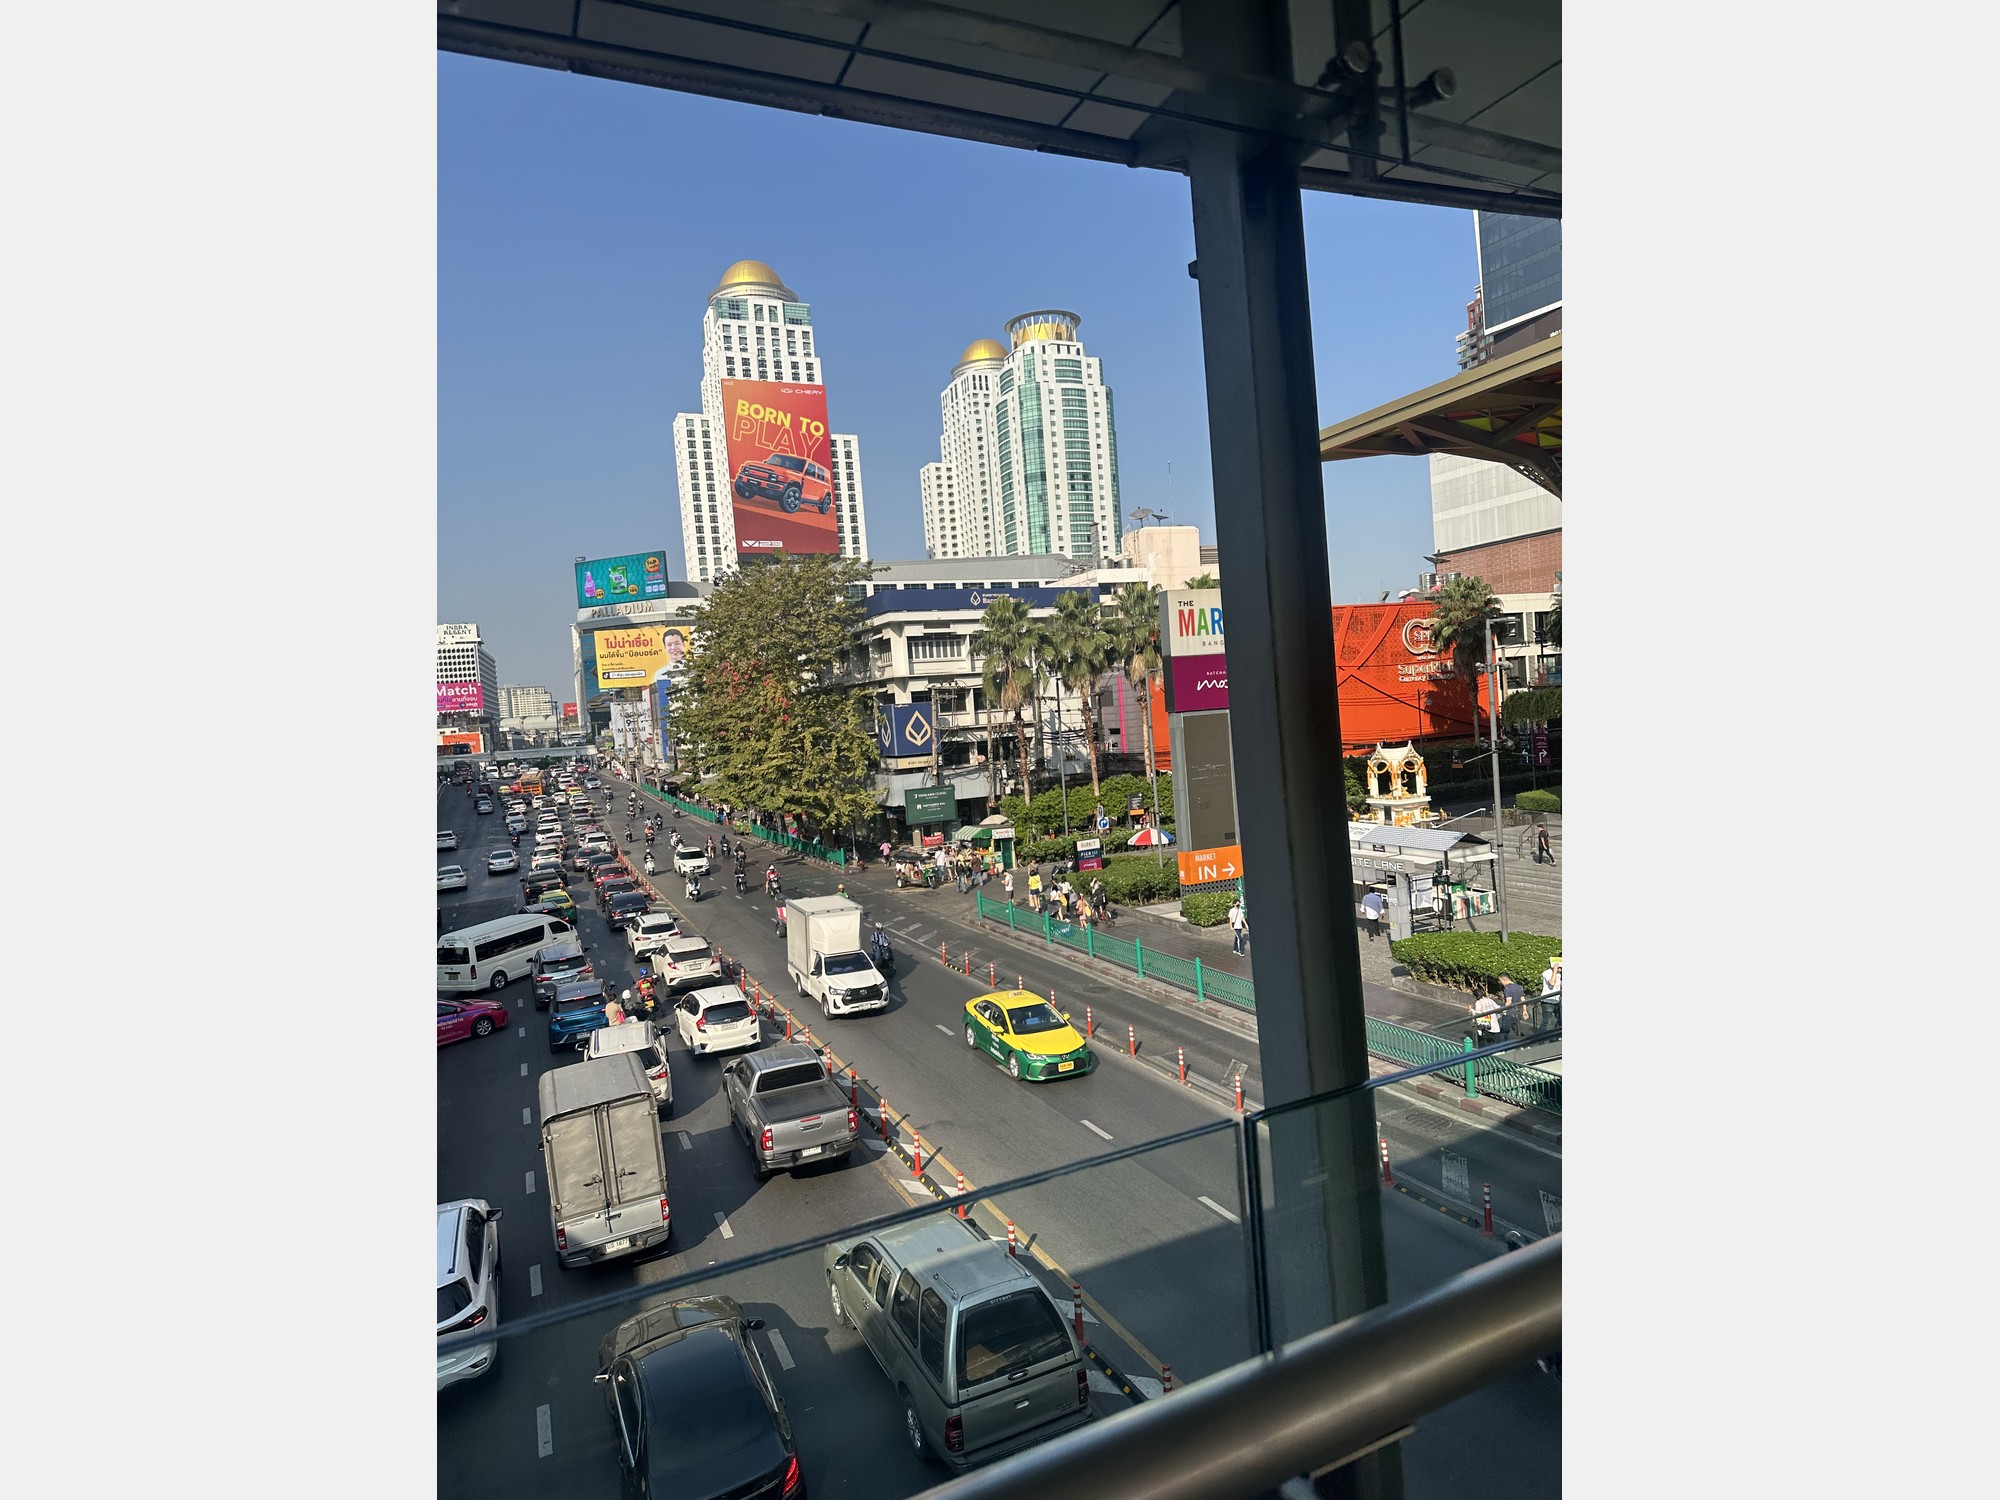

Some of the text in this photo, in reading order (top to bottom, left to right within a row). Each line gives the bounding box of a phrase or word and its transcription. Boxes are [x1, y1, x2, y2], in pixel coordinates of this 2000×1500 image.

[736, 399, 825, 437] BORN TO
[733, 413, 823, 460] PLAY
[591, 601, 654, 618] PALLADIUM
[604, 633, 654, 649] ไม่น่าเชื่อ!
[1398, 660, 1454, 675] SuperRich
[1195, 853, 1216, 861] MARKET
[1198, 864, 1217, 880] IN
[1373, 860, 1405, 872] LANE
